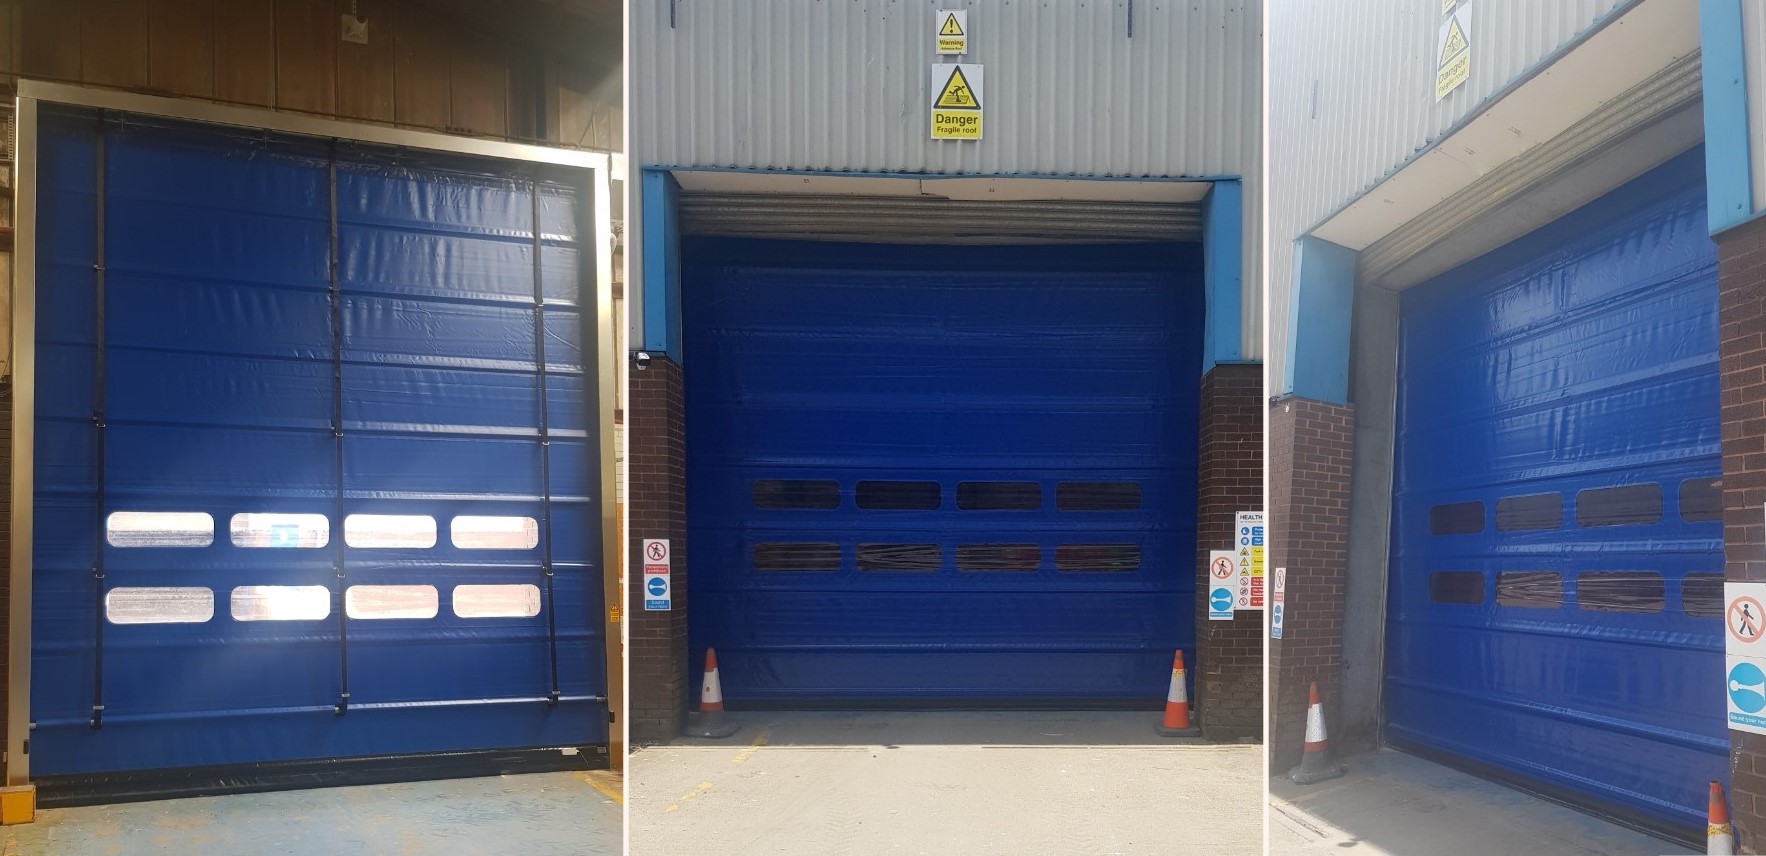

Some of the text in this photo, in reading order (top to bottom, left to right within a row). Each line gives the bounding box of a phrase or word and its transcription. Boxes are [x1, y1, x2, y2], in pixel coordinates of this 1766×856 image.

[1439, 56, 1467, 85] Danger
[936, 114, 978, 127] Danger
[937, 126, 960, 134] Fragile
